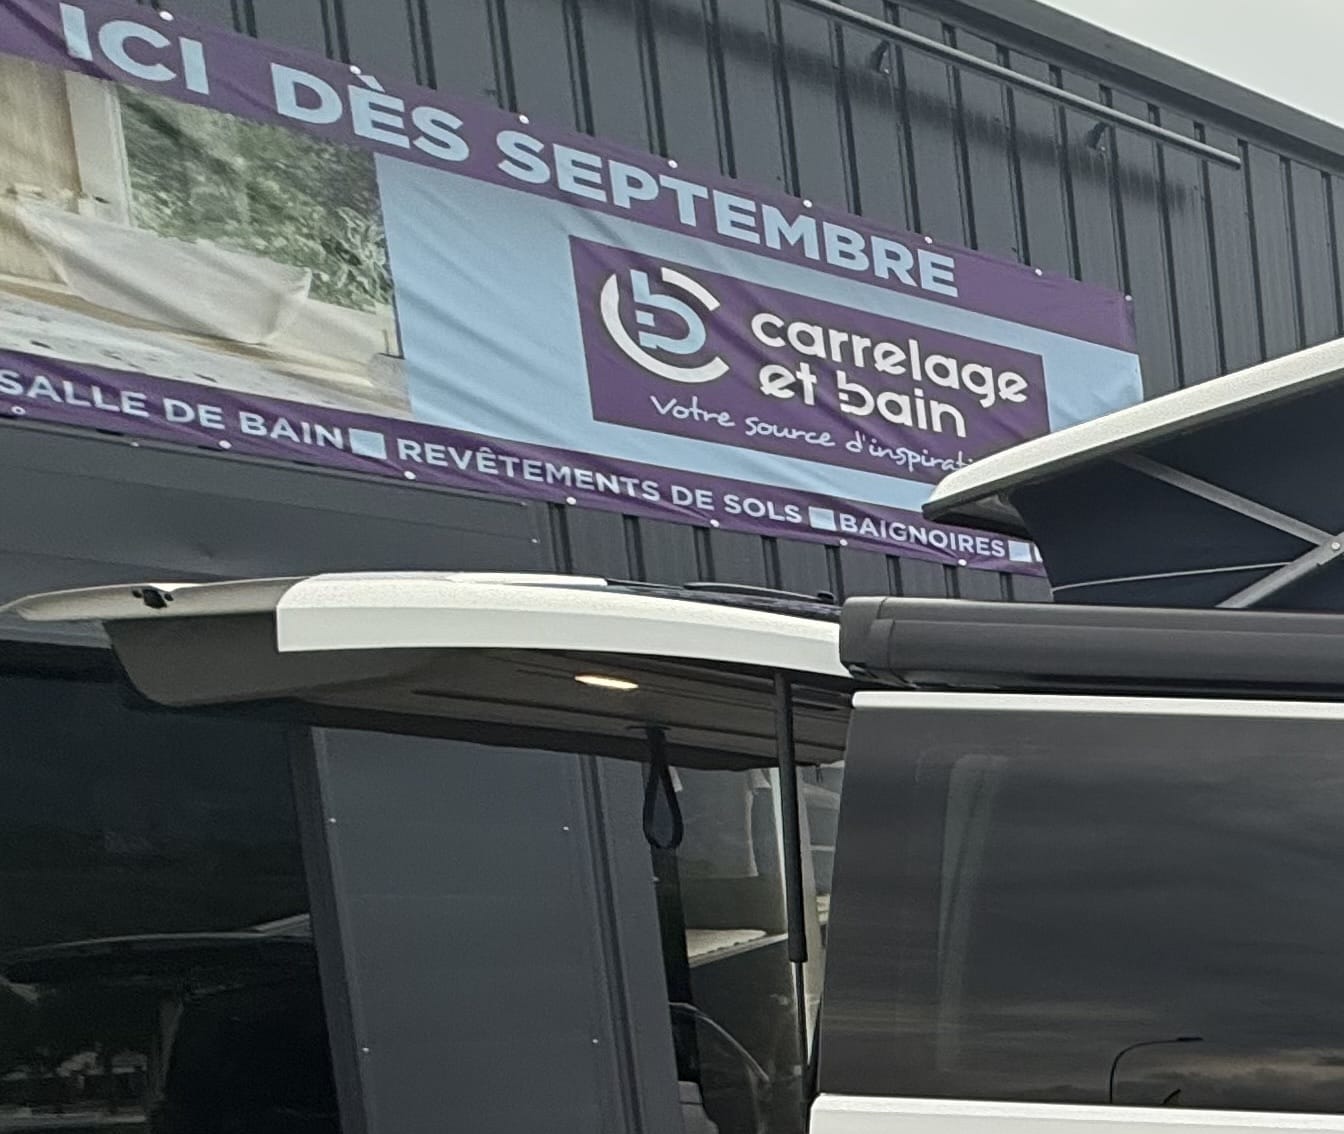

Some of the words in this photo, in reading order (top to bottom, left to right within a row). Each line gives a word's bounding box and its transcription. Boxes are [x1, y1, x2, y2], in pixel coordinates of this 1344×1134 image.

[60, 2, 209, 94] ICI
[270, 63, 470, 162] DÈS
[495, 129, 959, 298] SEPTEMBRE
[750, 312, 1028, 408] carrelage
[759, 360, 817, 405] et
[836, 370, 967, 438] bain
[0, 370, 150, 418] SALLE
[162, 397, 226, 431] DE
[239, 410, 345, 451] BAIN
[396, 437, 661, 502] REVÊTEMENTS
[670, 484, 714, 511] DE
[723, 494, 803, 524] SOLS
[839, 512, 1006, 557] BAIGNOIRES
[650, 395, 736, 427] Votre
[744, 416, 836, 447] source
[845, 429, 975, 471] d'inspirat
